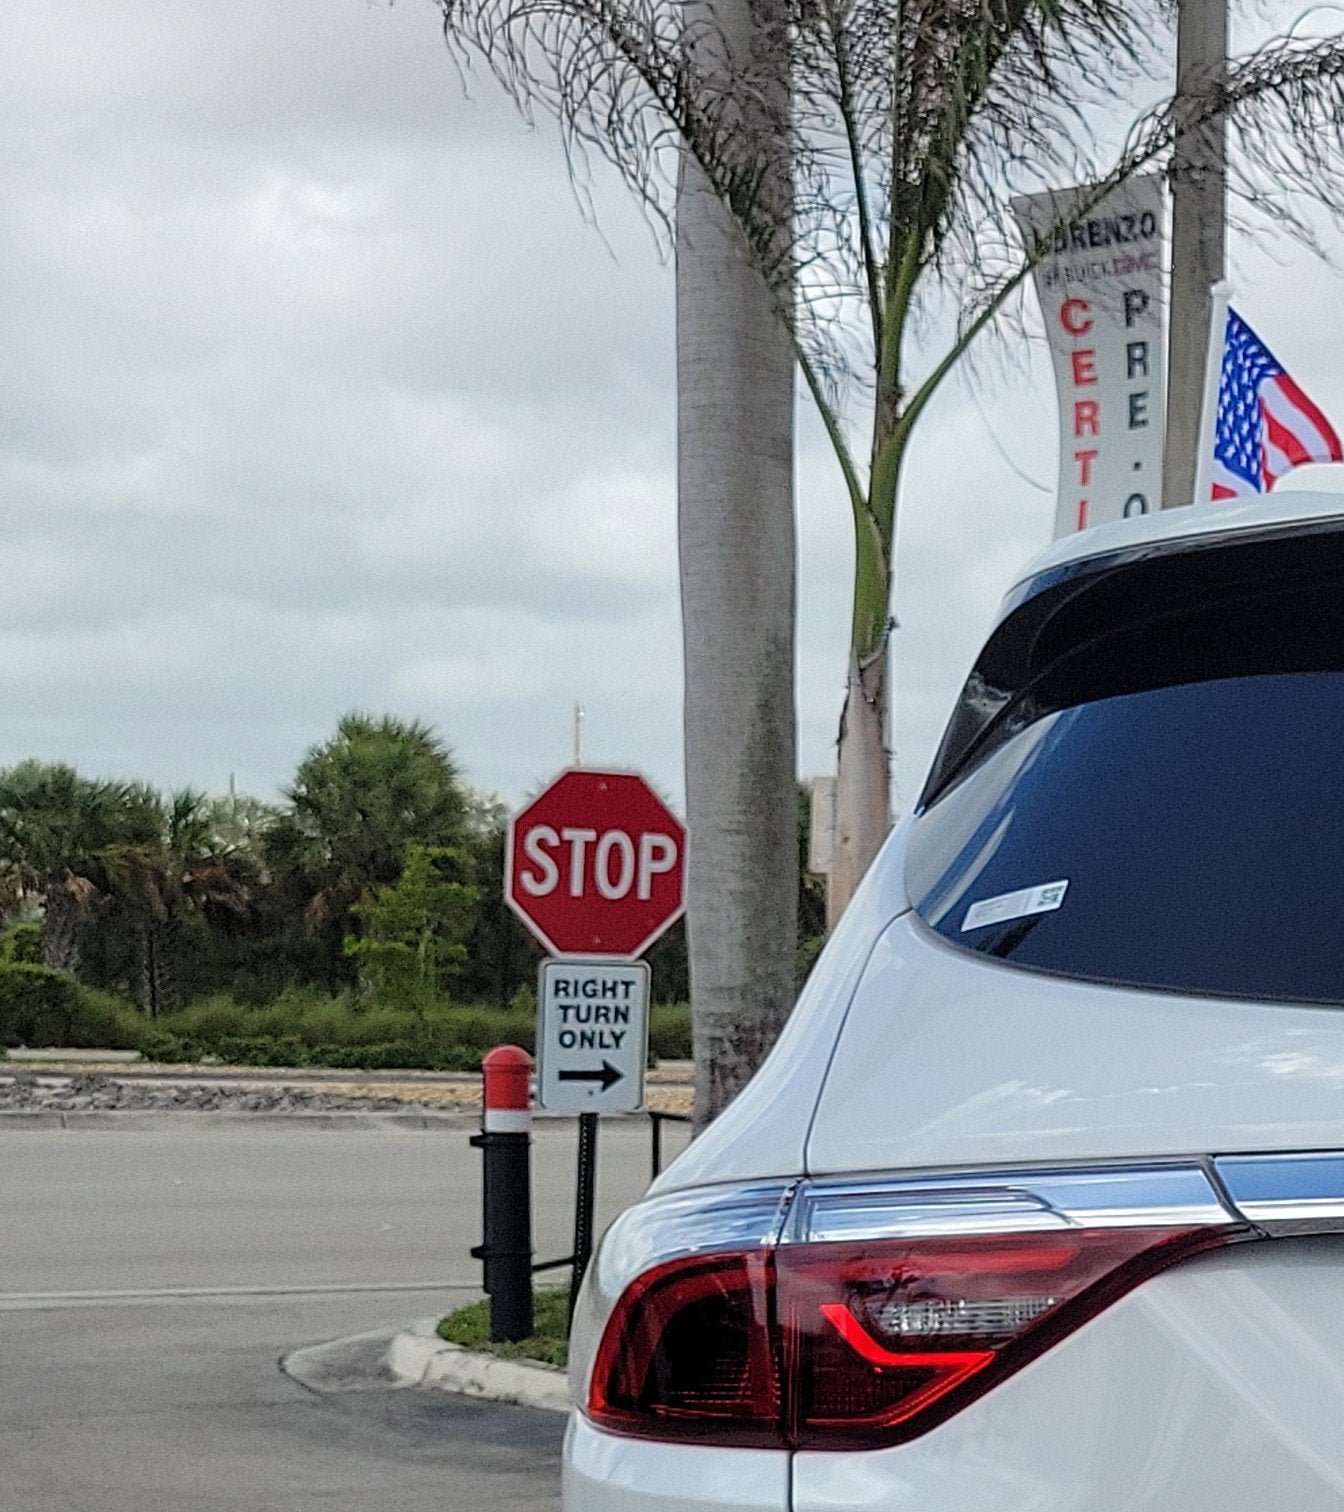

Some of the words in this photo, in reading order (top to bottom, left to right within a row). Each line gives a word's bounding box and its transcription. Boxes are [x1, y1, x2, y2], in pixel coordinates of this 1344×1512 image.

[519, 825, 678, 901] STOP
[554, 980, 636, 1000] RIGHT
[558, 1005, 629, 1025] TURN
[558, 1030, 627, 1050] ONLY
